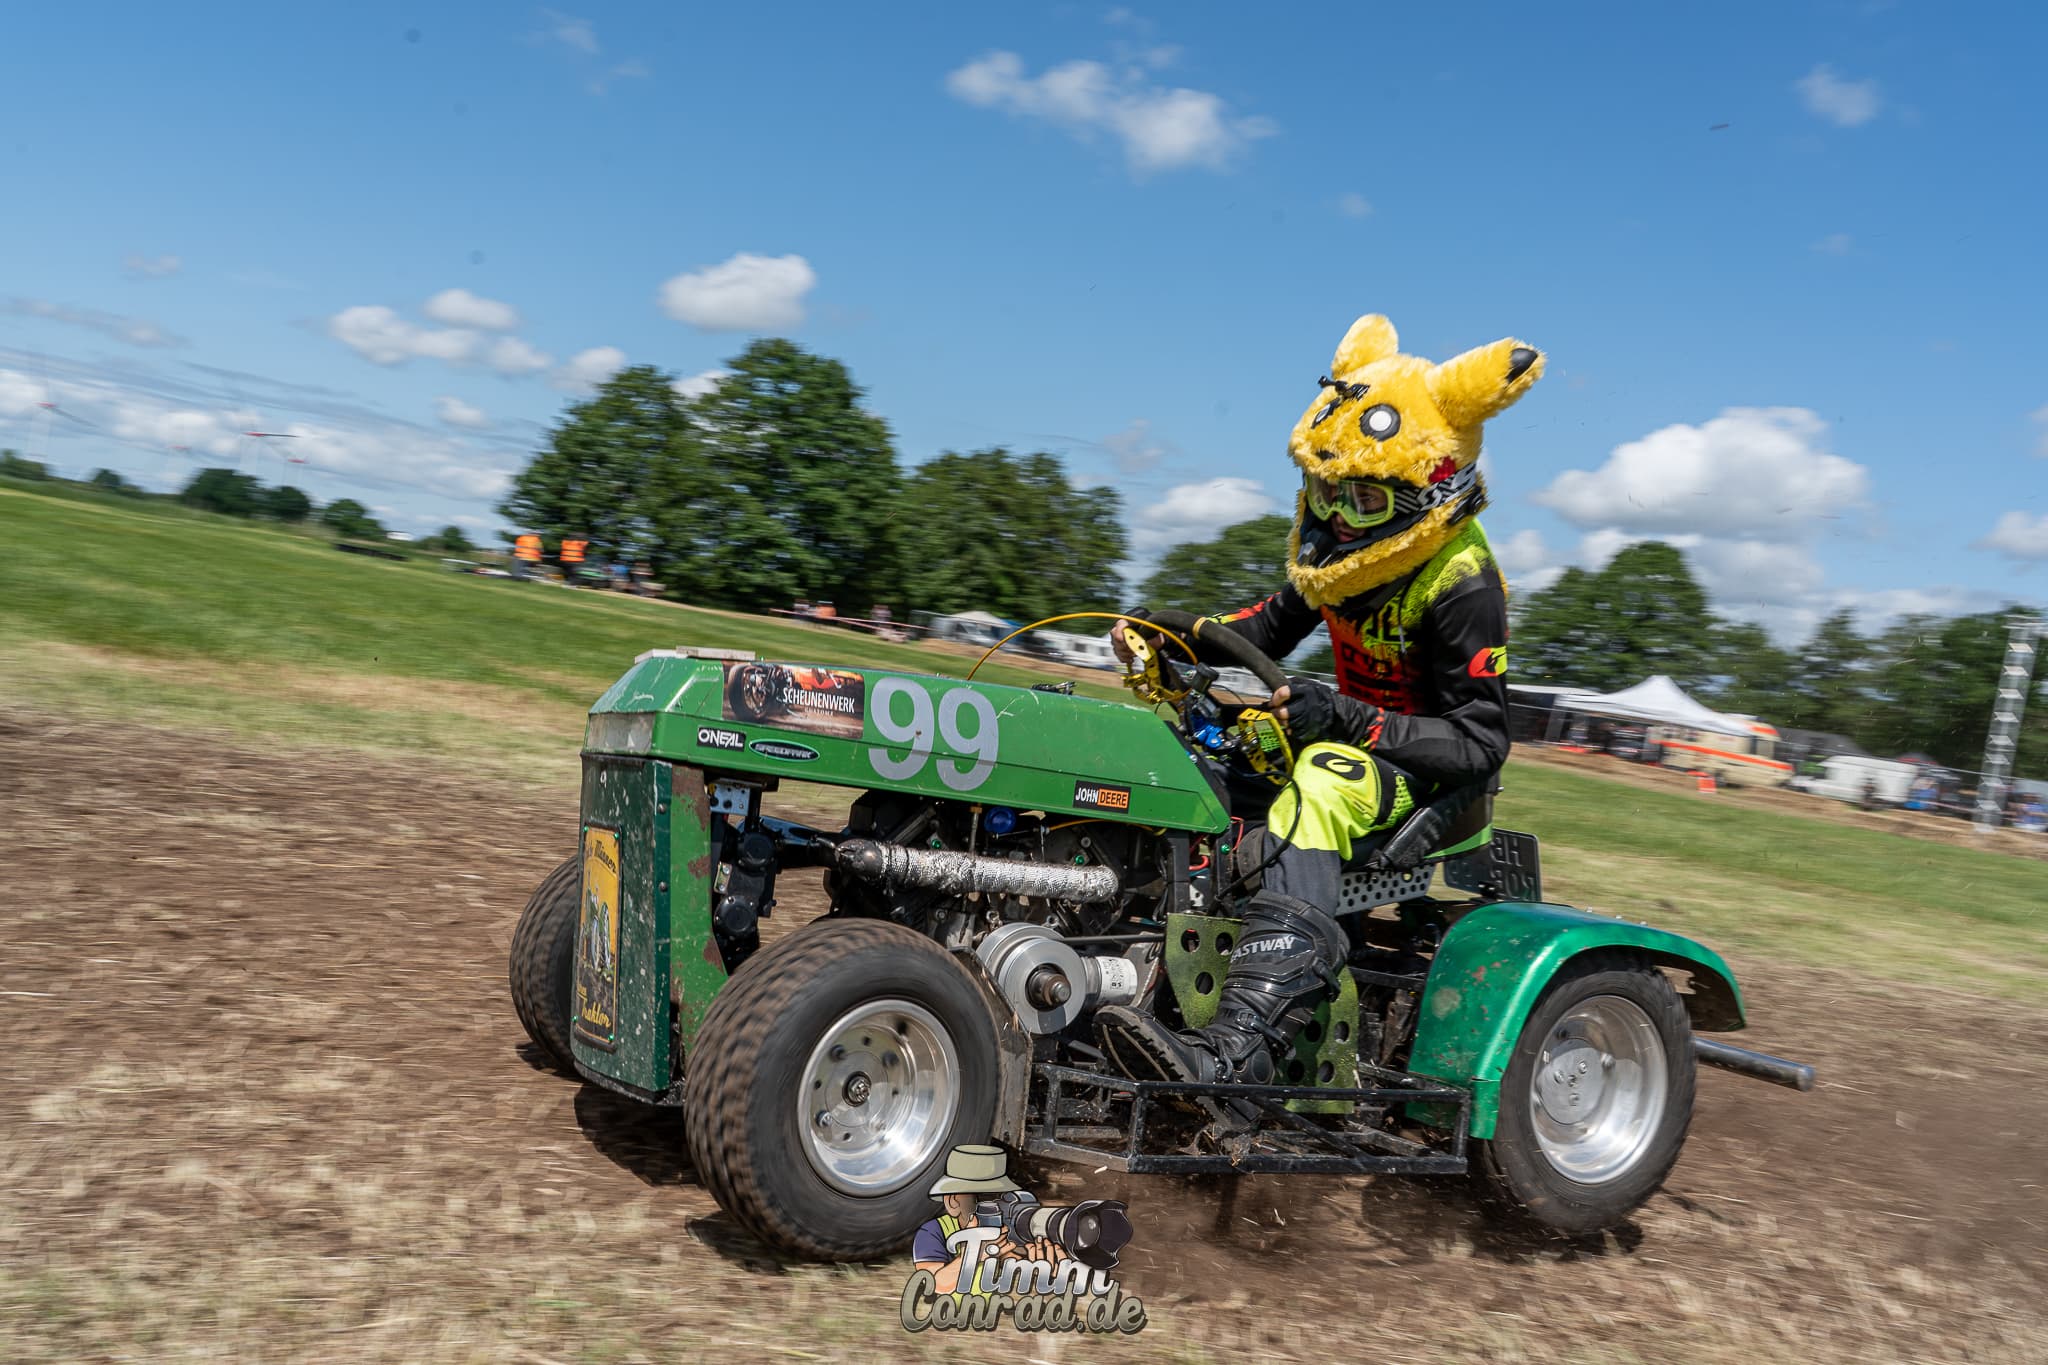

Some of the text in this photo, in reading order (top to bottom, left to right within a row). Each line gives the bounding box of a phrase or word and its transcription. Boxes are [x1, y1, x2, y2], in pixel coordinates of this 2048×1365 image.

[782, 687, 855, 713] SCHEUNENWERK
[868, 677, 999, 791] 99
[1075, 787, 1128, 807] JOHN DEERE
[1230, 934, 1296, 964] ASTWAY
